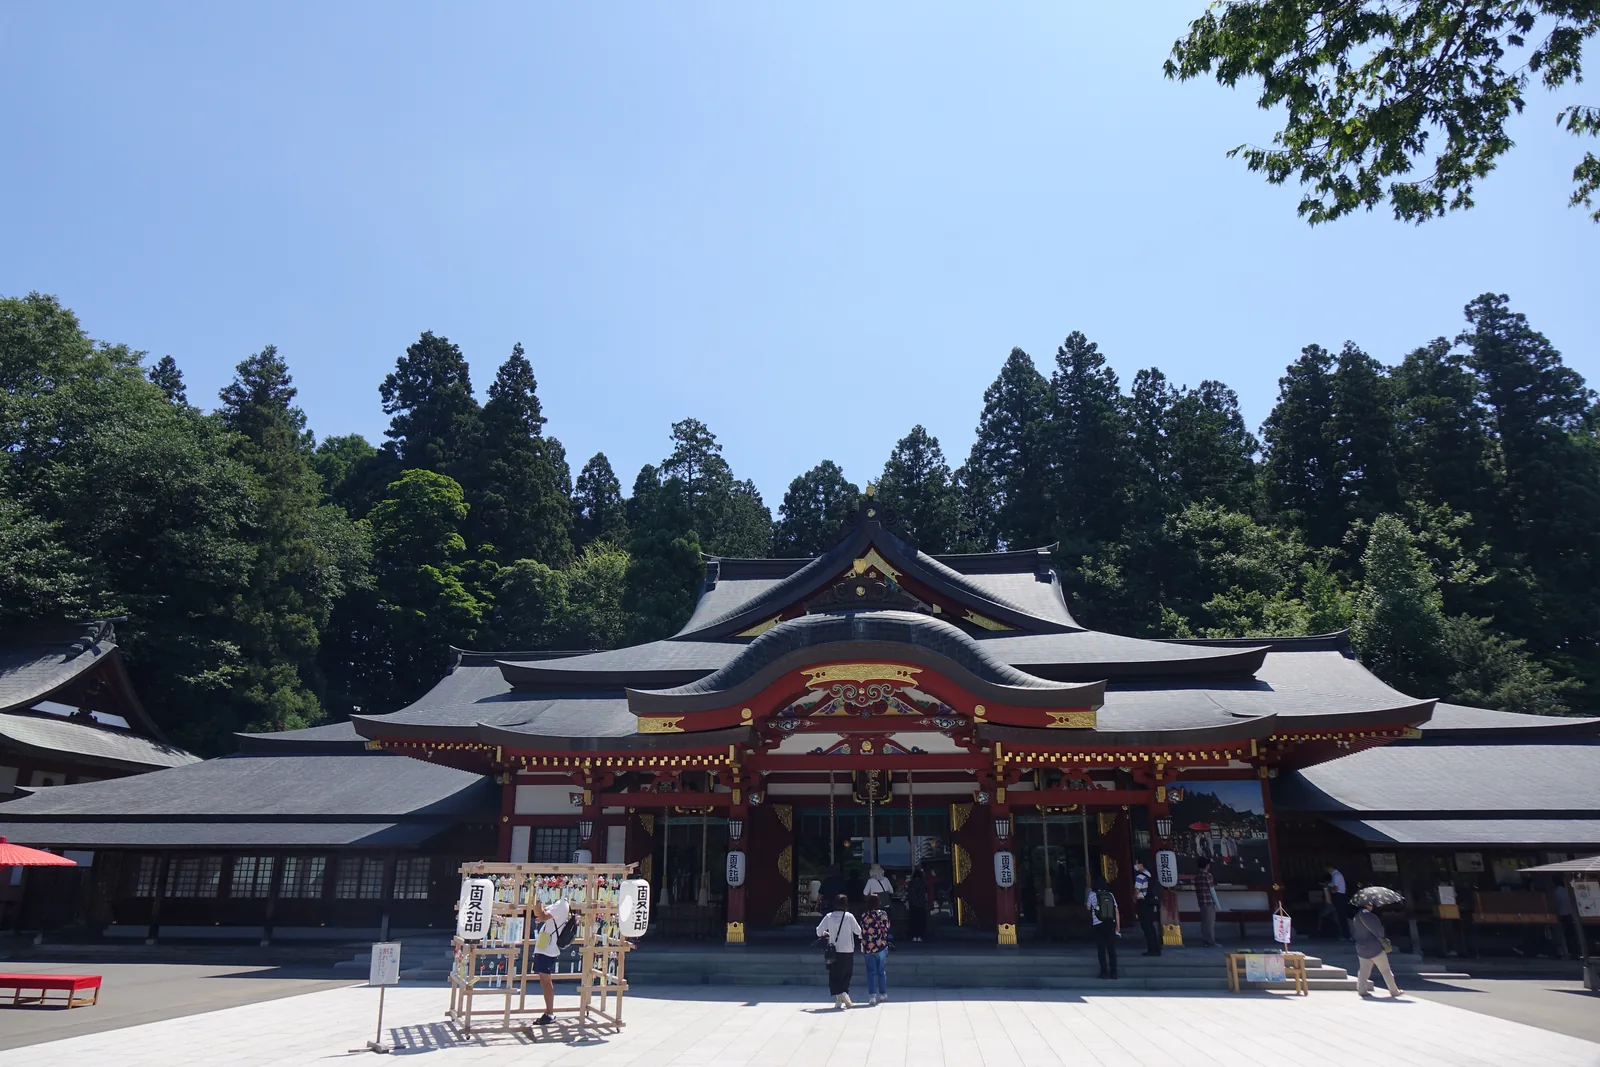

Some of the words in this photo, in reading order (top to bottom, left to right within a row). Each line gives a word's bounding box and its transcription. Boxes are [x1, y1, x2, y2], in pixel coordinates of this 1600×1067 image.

[728, 854, 739, 882] 夏詣
[1001, 855, 1012, 883] 夏詣
[1160, 853, 1173, 883] 夏詣
[464, 884, 485, 932] 夏詣
[633, 885, 648, 931] 夏詣
